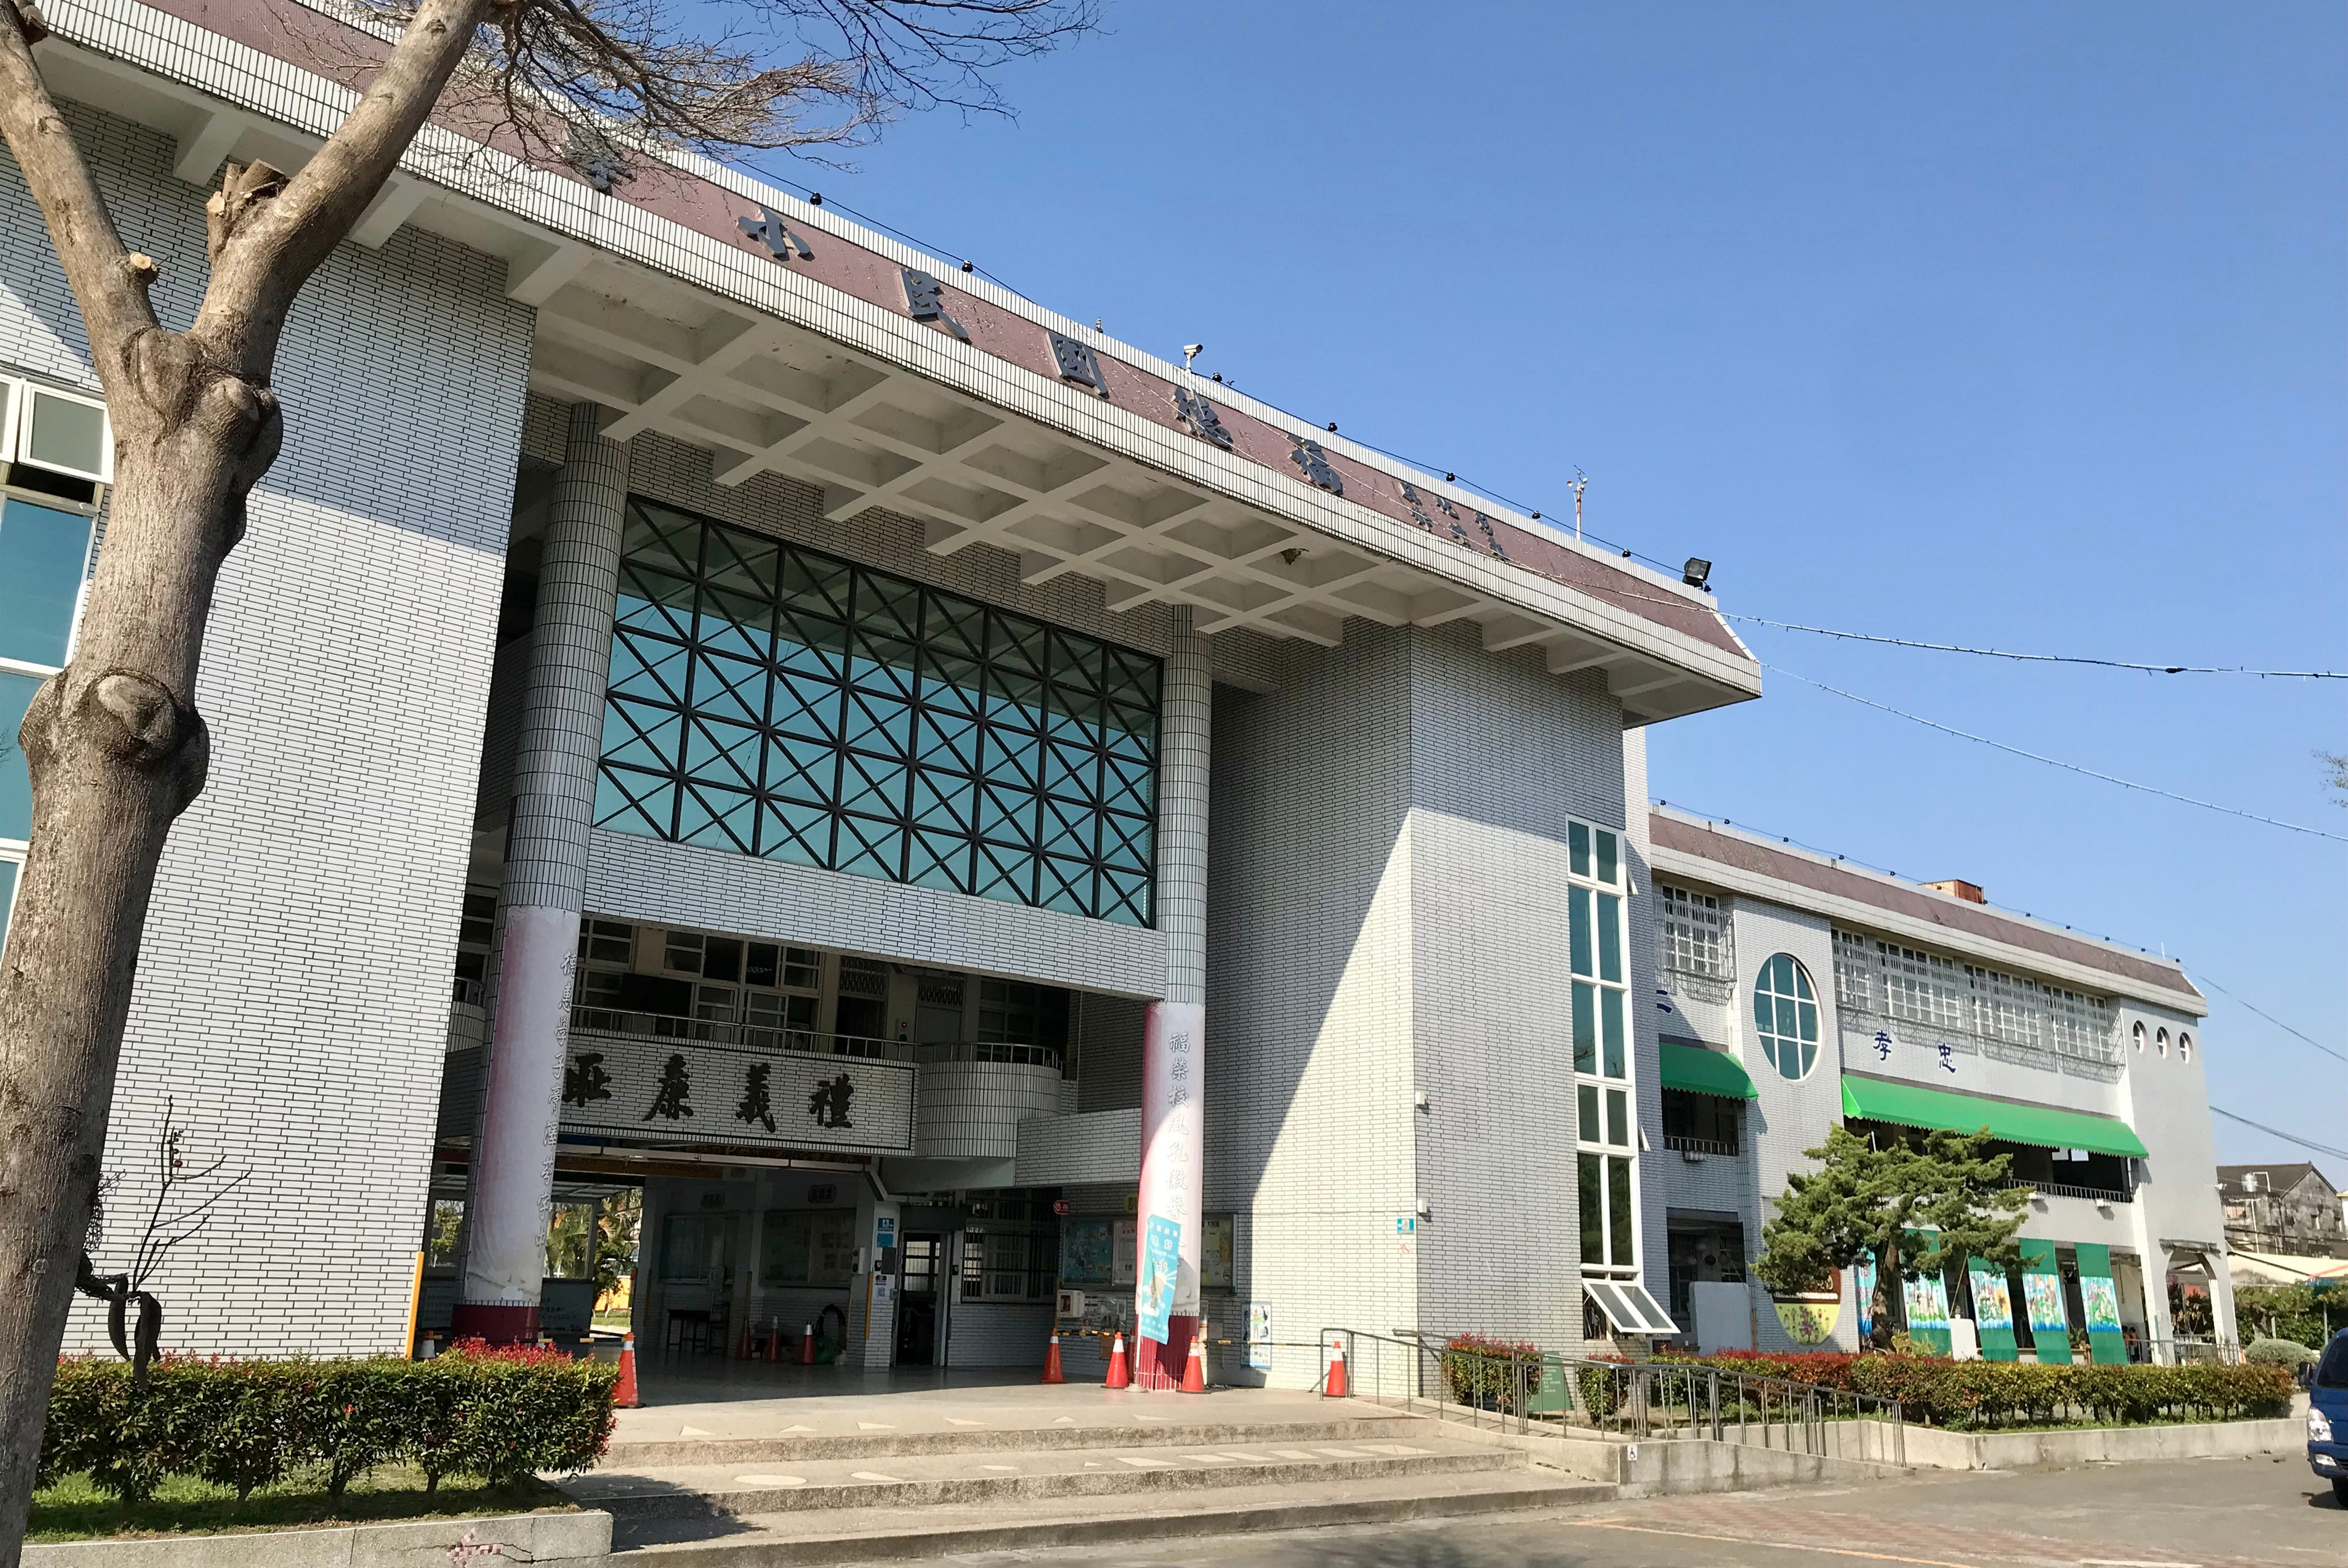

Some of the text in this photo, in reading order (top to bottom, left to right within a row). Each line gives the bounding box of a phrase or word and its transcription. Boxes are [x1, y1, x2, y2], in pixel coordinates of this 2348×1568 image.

[1165, 1032, 1191, 1267] 福榮校風孔徽譽
